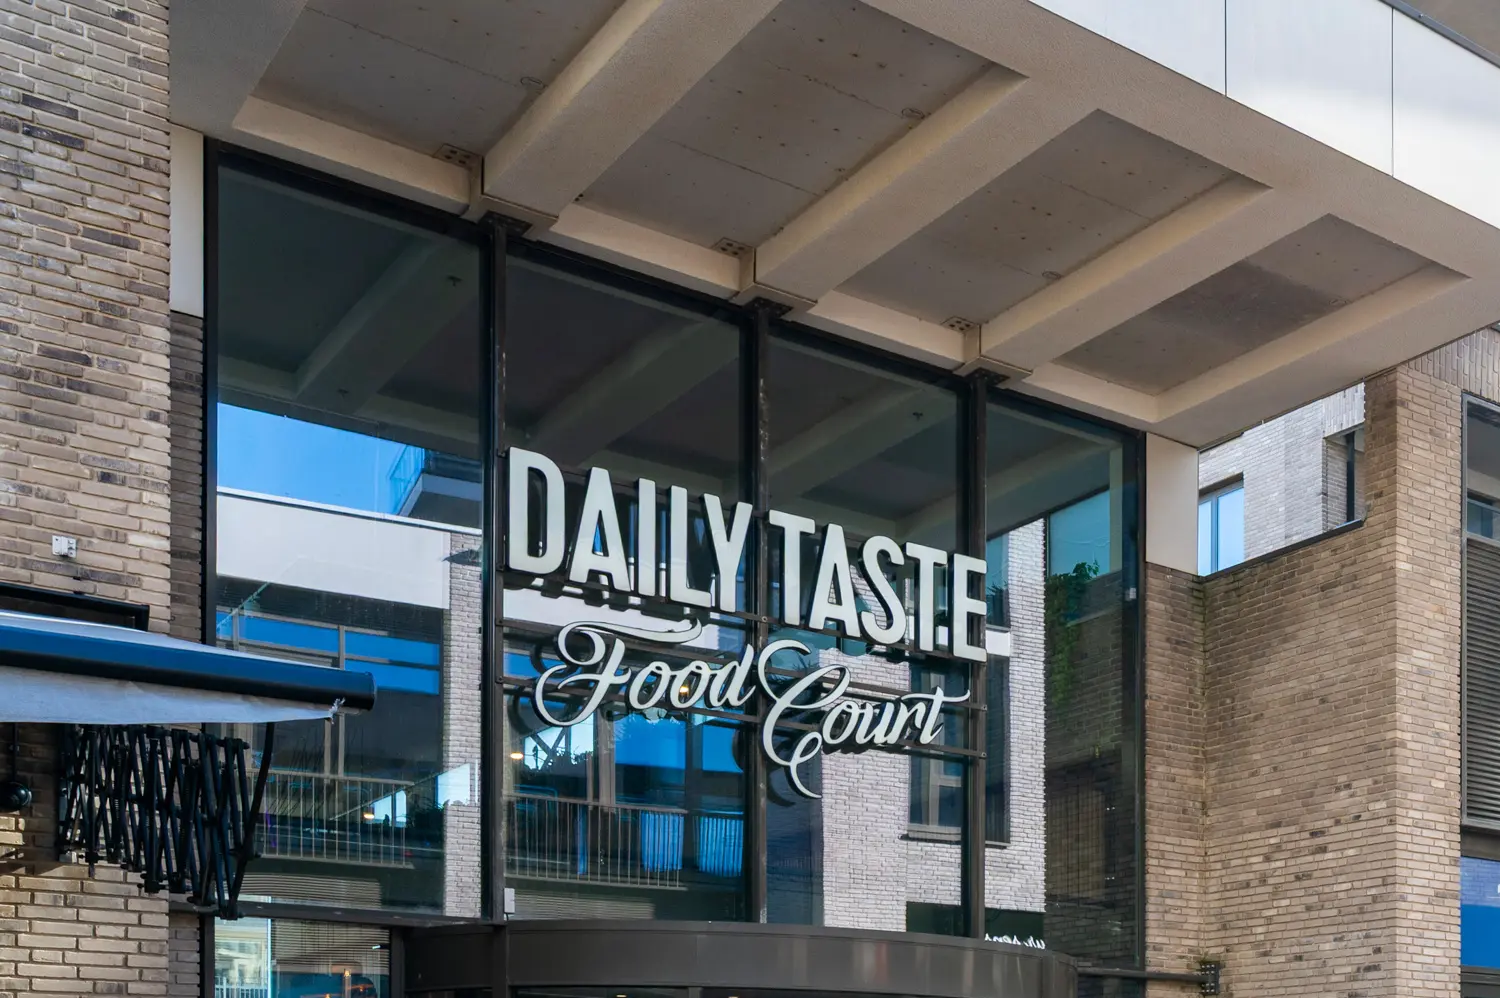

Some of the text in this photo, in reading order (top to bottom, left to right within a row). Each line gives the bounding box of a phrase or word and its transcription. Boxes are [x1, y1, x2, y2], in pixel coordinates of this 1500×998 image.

[508, 446, 988, 663] DAILY TASTE
[535, 619, 971, 798] Food Court
